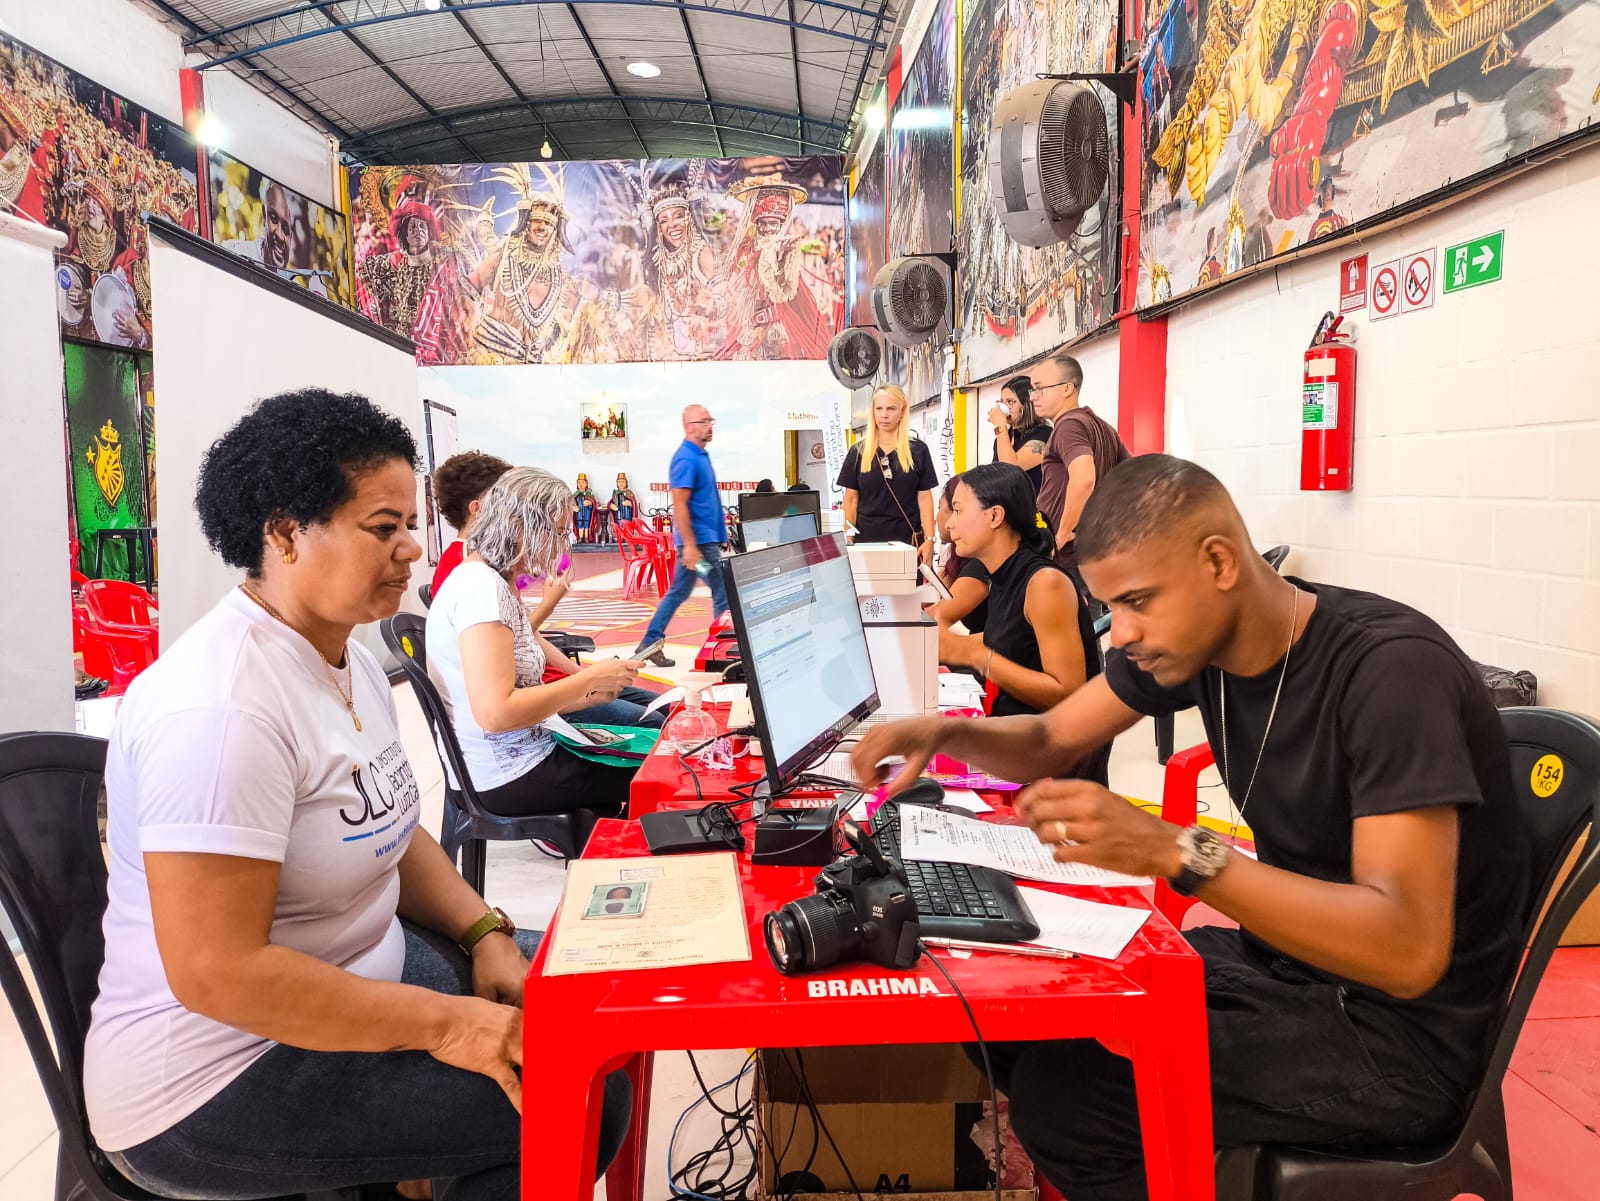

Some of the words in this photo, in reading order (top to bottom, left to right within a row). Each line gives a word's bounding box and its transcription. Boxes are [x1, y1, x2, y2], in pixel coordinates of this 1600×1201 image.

[1537, 763, 1560, 782] 154
[1539, 780, 1552, 792] KG
[808, 977, 940, 998] BRAHMA
[873, 1173, 911, 1193] A4
